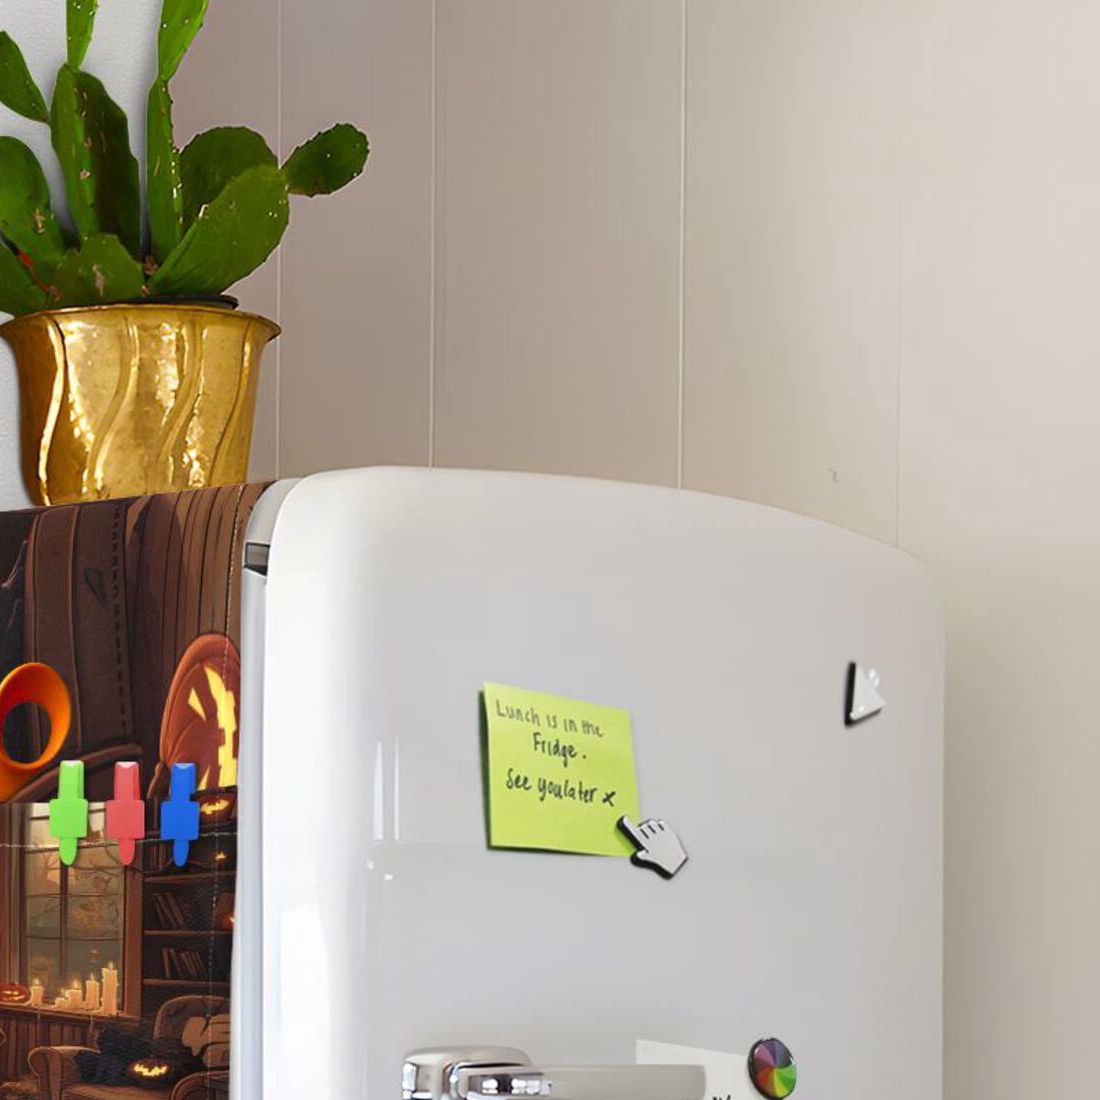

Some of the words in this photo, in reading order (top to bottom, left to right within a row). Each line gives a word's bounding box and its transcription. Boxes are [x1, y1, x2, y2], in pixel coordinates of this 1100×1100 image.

[496, 699, 540, 726] Lunch
[546, 714, 557, 729] is
[564, 718, 577, 732] in
[582, 719, 604, 737] the
[506, 767, 532, 791] See
